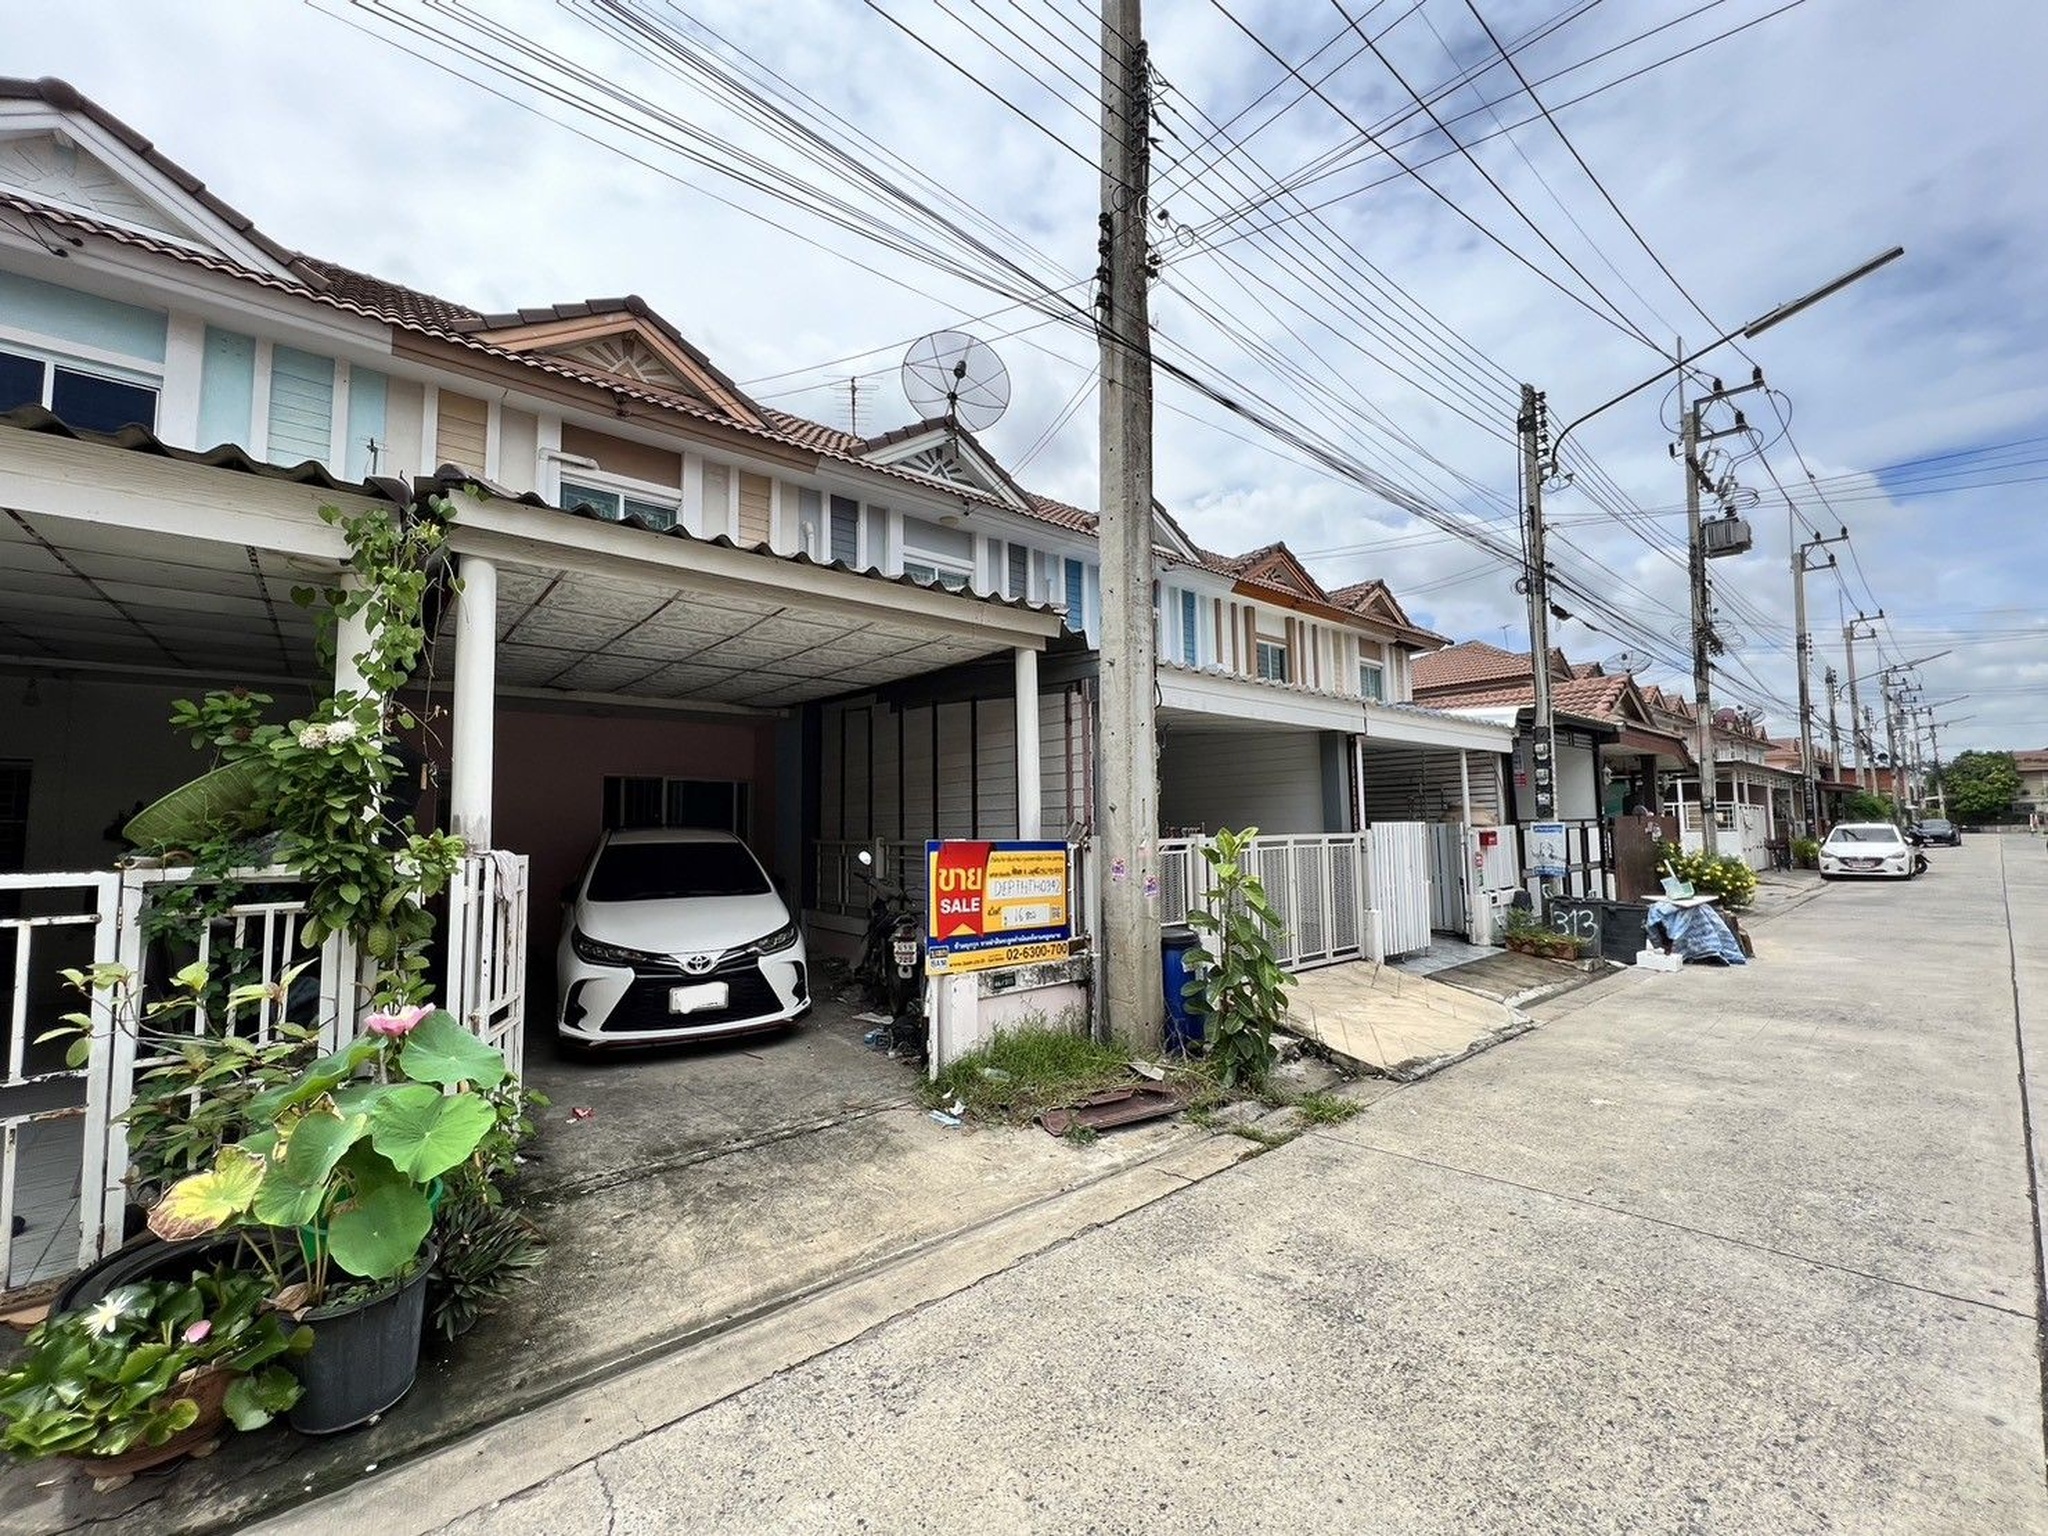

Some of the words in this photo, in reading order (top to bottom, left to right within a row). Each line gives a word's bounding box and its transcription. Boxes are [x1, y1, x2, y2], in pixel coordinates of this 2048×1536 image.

[939, 867, 981, 891] ขาย
[940, 897, 980, 914] SALE
[1553, 909, 1598, 940] 313
[1006, 943, 1067, 960] 02-6300-700
